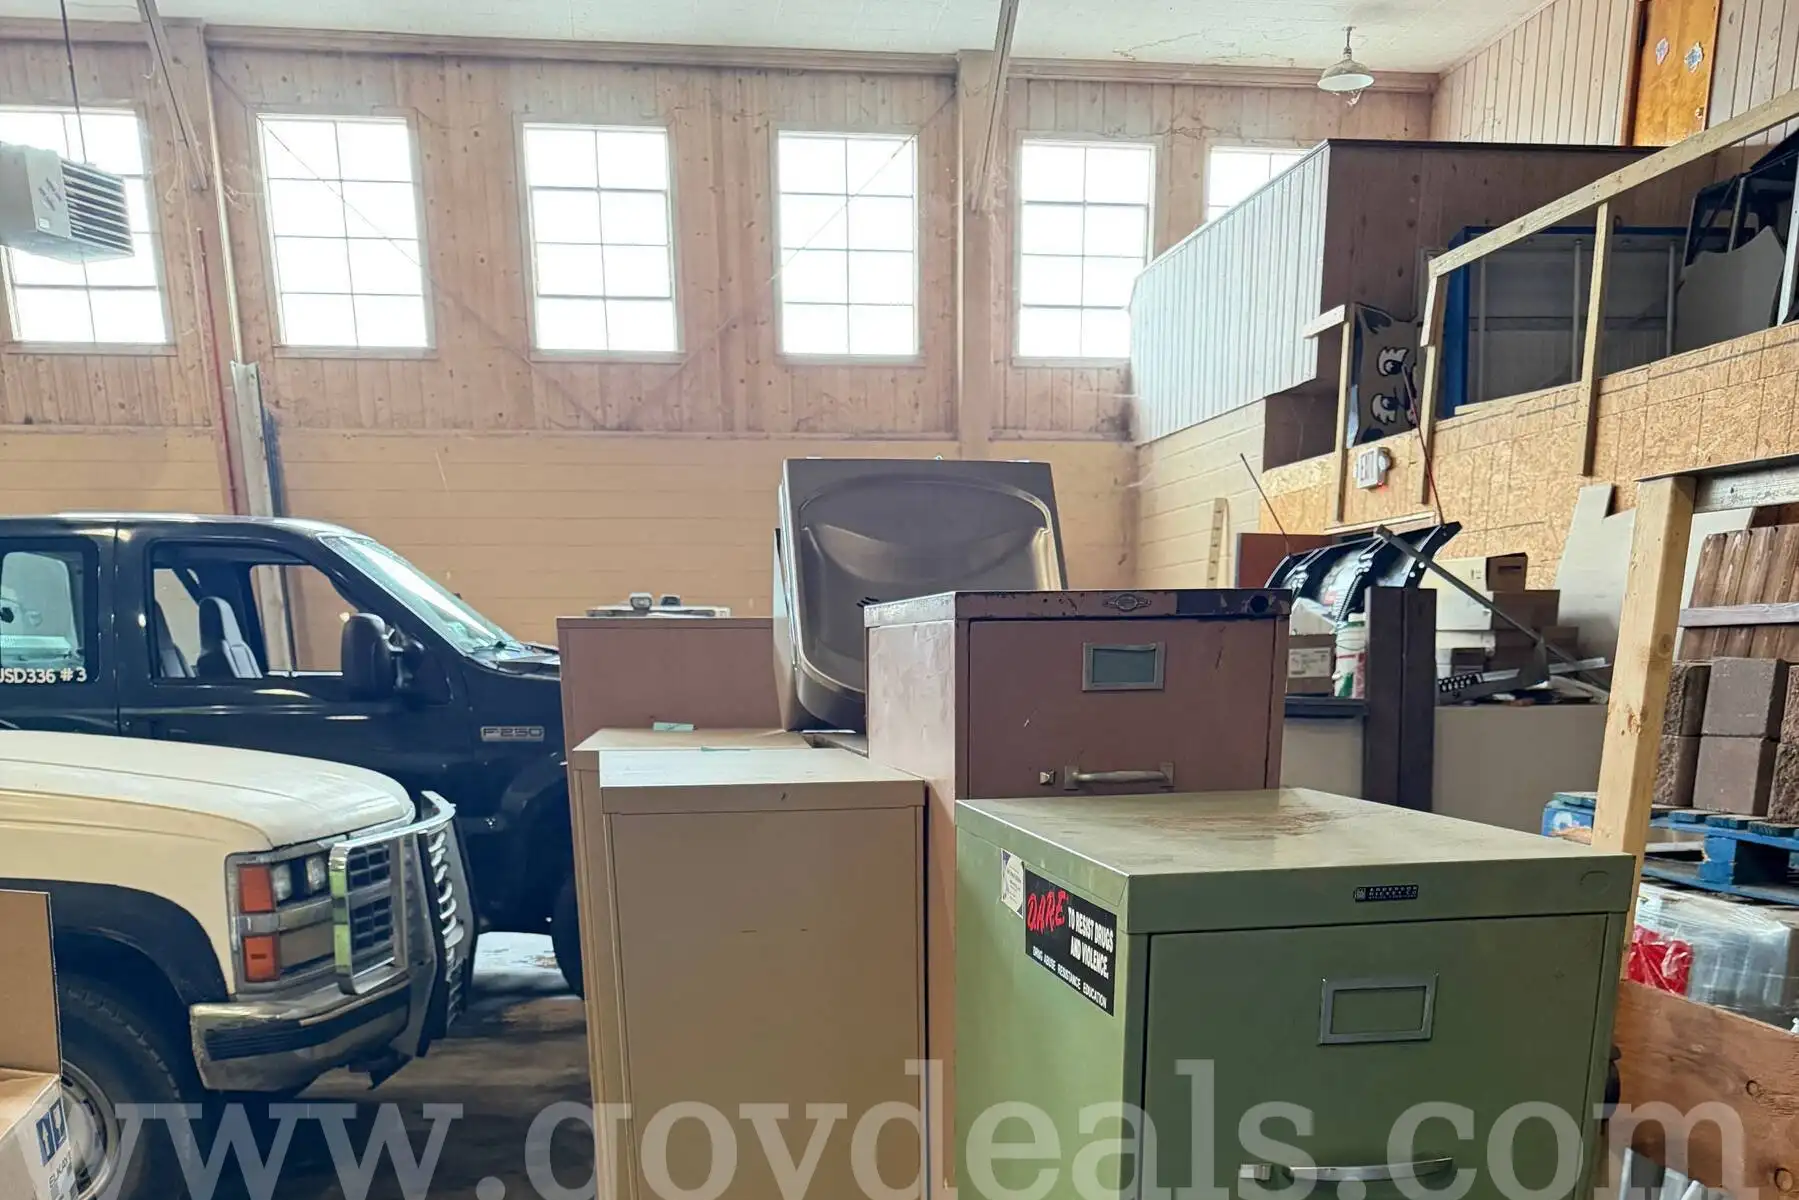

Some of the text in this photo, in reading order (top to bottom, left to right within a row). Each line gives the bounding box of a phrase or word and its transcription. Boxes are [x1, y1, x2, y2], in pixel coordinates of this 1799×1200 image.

[1075, 911, 1094, 941] RESIST
[1094, 921, 1114, 953] DRUGS
[1070, 935, 1081, 960] AND
[1082, 981, 1107, 1009] EDUCATION
